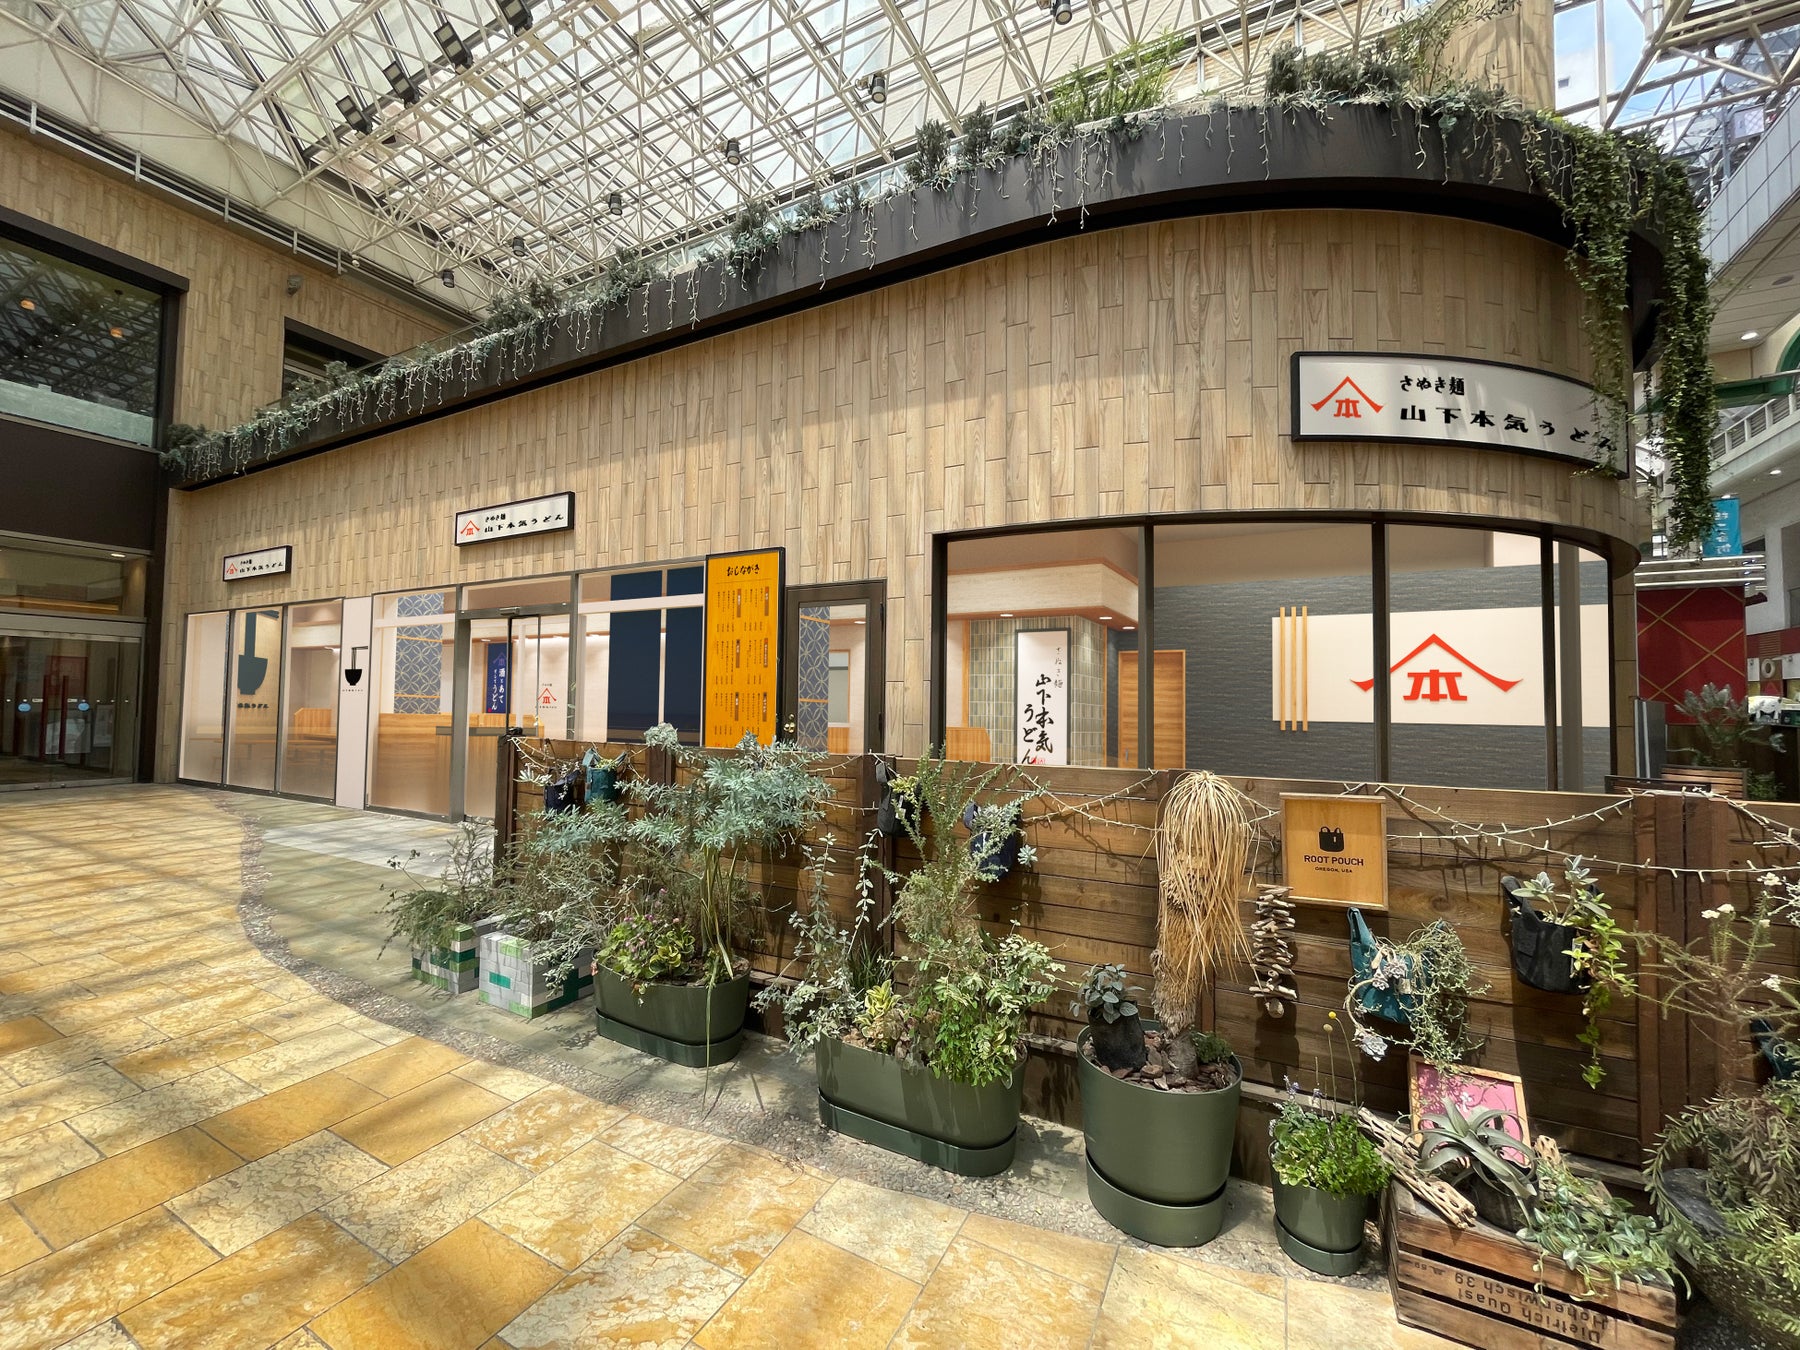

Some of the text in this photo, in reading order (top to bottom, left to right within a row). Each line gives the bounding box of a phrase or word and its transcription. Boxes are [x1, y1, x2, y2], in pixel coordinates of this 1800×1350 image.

[1400, 375, 1465, 396] さぬき麺
[1400, 405, 1617, 451] 山下本気うどん
[484, 514, 564, 533] 山下本気うどん
[727, 564, 760, 576] おしながき
[1035, 674, 1054, 753] 山下本気
[1022, 704, 1038, 764] うどん
[1304, 854, 1364, 866] ROOT POUCH
[1454, 1272, 1477, 1288] 39
[1456, 1287, 1600, 1344] Dietrich Quast
